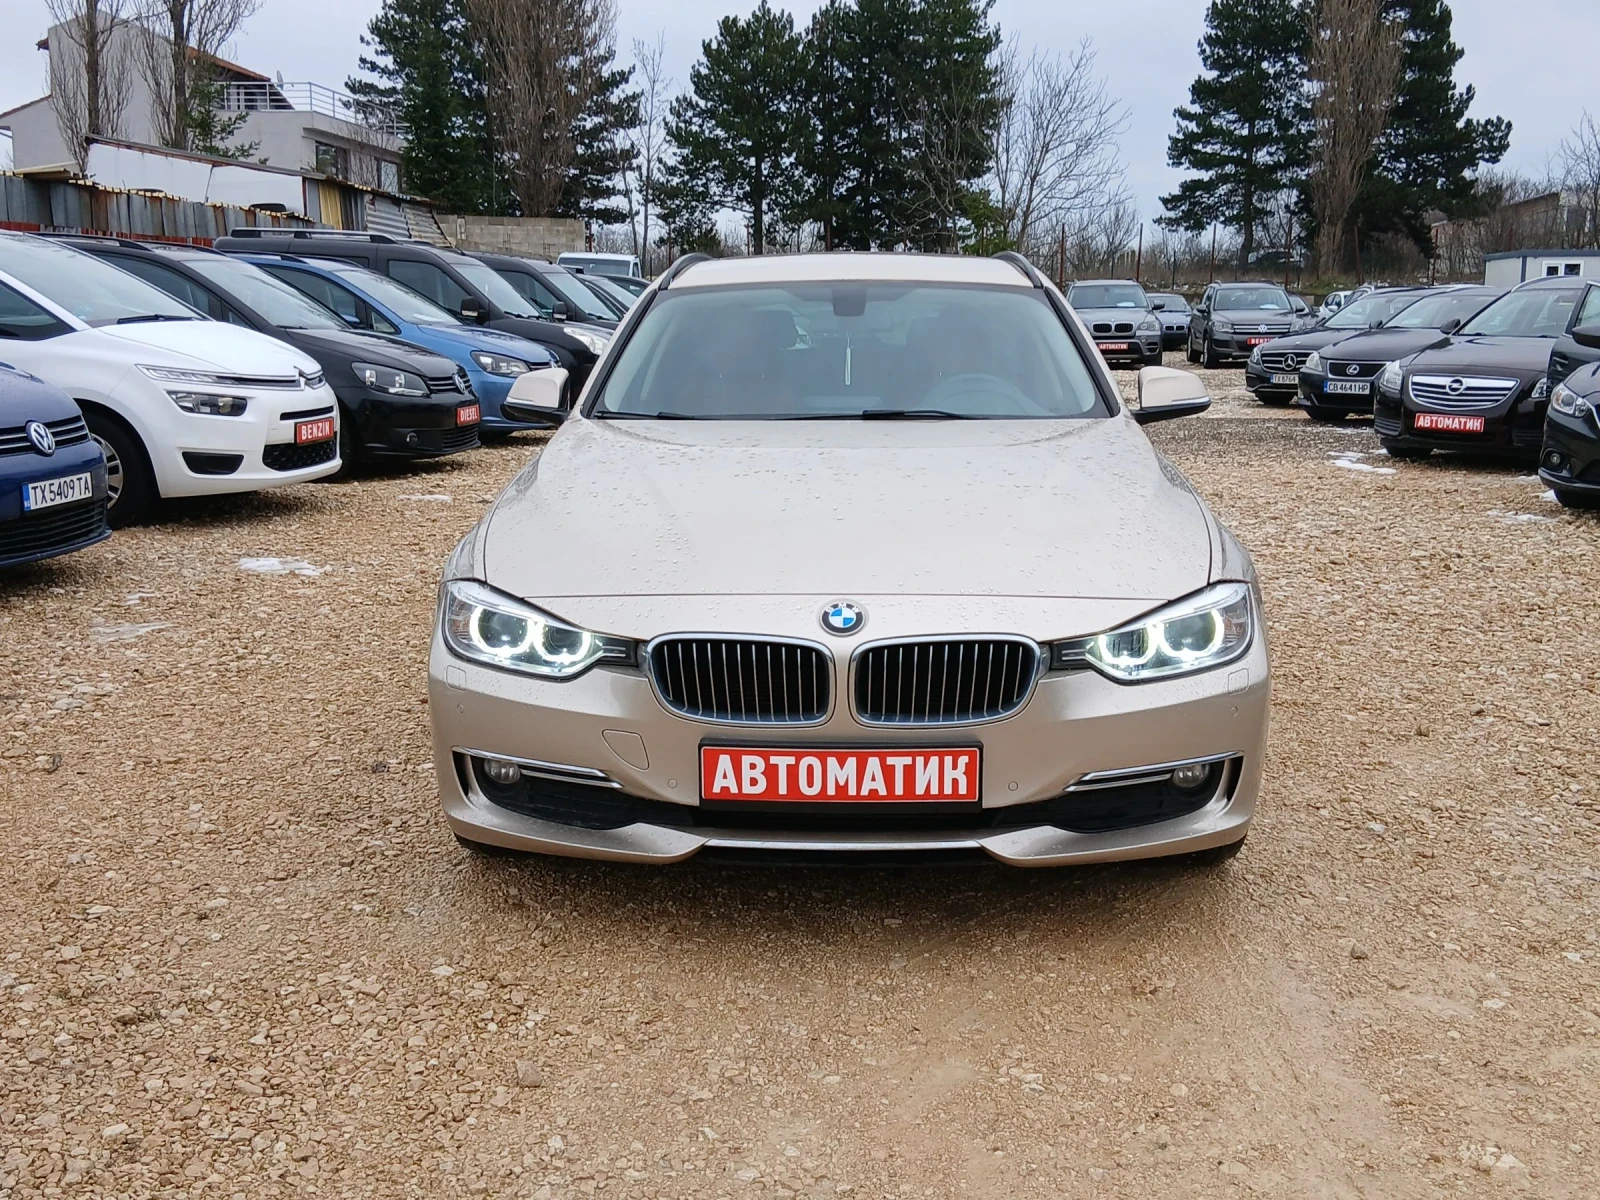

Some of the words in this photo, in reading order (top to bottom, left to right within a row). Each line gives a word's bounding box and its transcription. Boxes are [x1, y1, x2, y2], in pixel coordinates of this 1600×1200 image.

[1340, 384, 1357, 393] 4641
[460, 407, 478, 421] DIESEL
[301, 420, 330, 440] BENZIN
[1417, 416, 1482, 430] АВТОМАТИК
[712, 754, 969, 797] АВТОМАТИК
